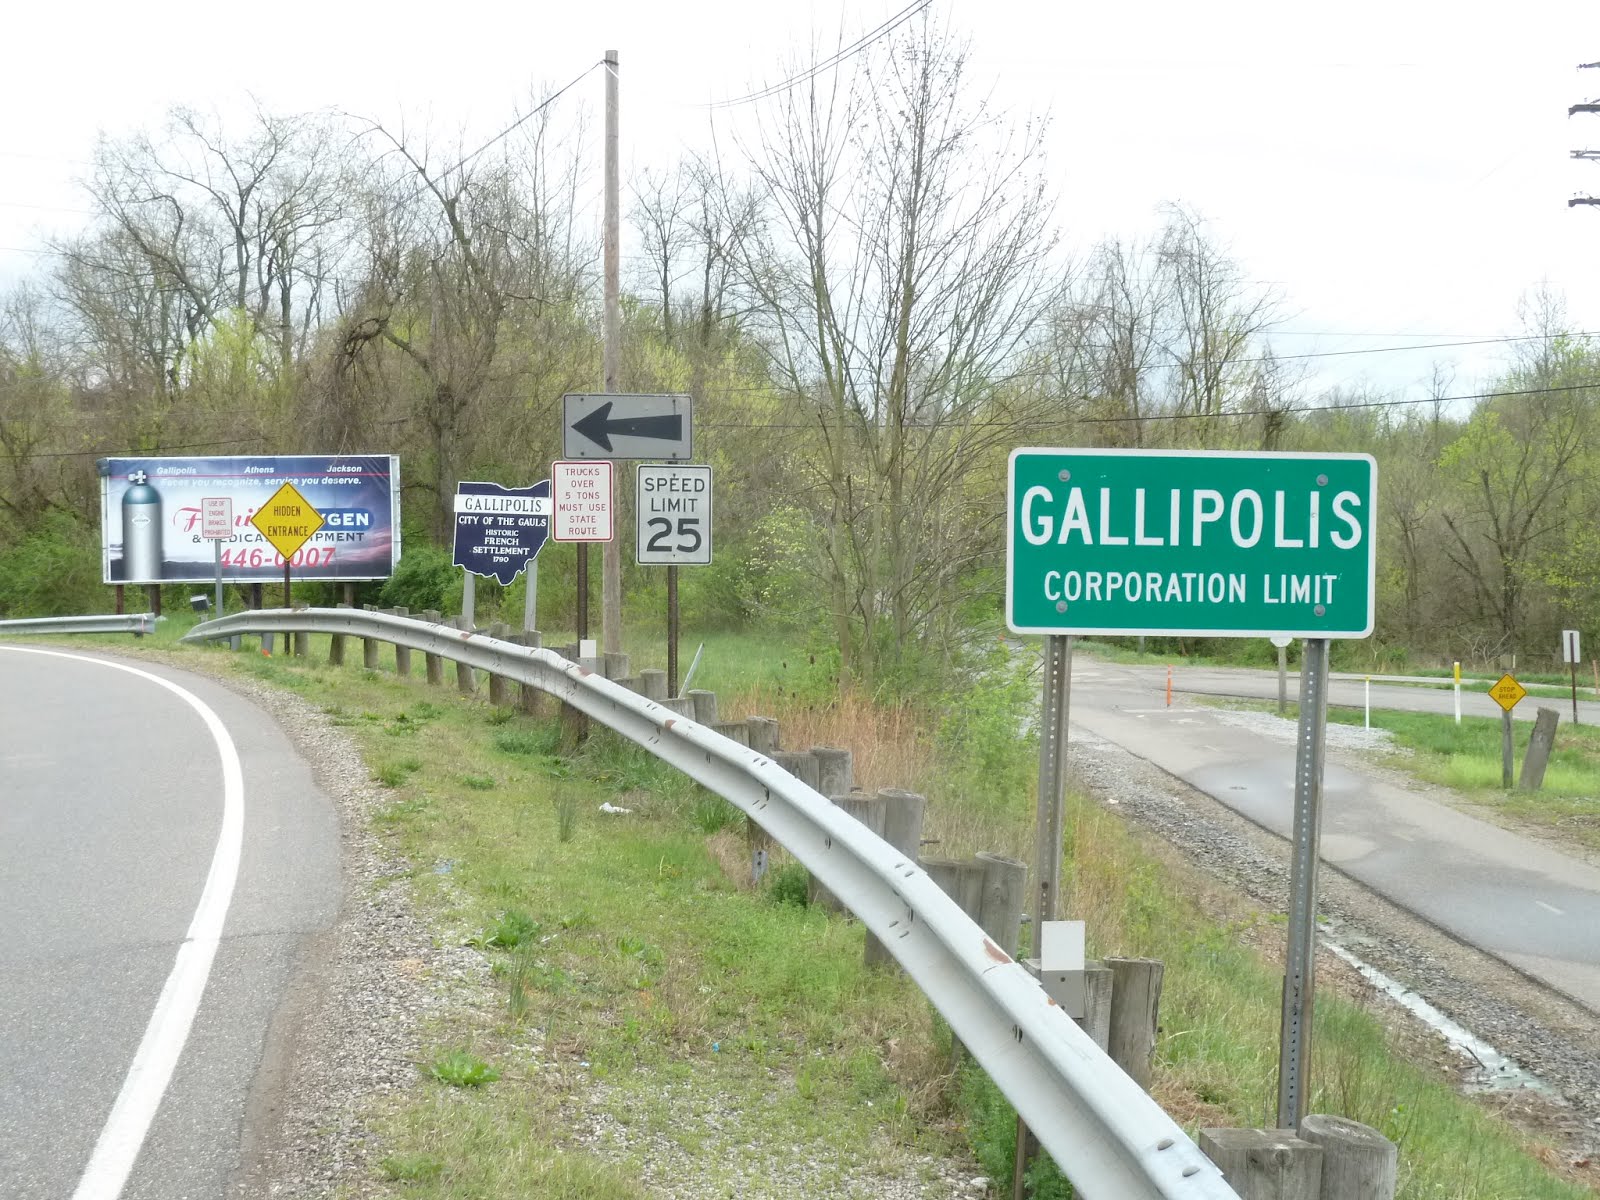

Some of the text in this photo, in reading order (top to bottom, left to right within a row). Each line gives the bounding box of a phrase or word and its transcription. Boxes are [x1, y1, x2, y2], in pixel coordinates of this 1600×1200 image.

[156, 466, 197, 476] Gallipolis
[243, 466, 275, 474] Athens
[326, 465, 362, 473] Jackson
[565, 468, 600, 476] TRUCKS
[192, 479, 210, 488] you
[264, 477, 299, 485] service
[301, 478, 319, 486] you
[321, 476, 362, 485] deserve.
[644, 477, 705, 492] SPEED
[565, 491, 600, 500] 5 TONS
[465, 497, 542, 513] GALLIPOLIS
[559, 503, 606, 512] MUST USE
[650, 498, 698, 513] LIMIT
[273, 506, 301, 517] HIDDEN
[458, 515, 547, 527] CITY OF THE GAULS
[569, 515, 596, 524] STATE
[1021, 485, 1363, 550] GALLIPOLIS
[267, 525, 309, 537] ENTRANCE
[485, 529, 519, 537] HISTORIC
[568, 527, 597, 535] ROUTE
[646, 517, 702, 553] 25
[208, 533, 268, 543] DICA
[484, 537, 519, 546] FRENCH
[472, 546, 530, 556] SETTLEMENT
[1043, 570, 1338, 605] CORPORATION LIMIT
